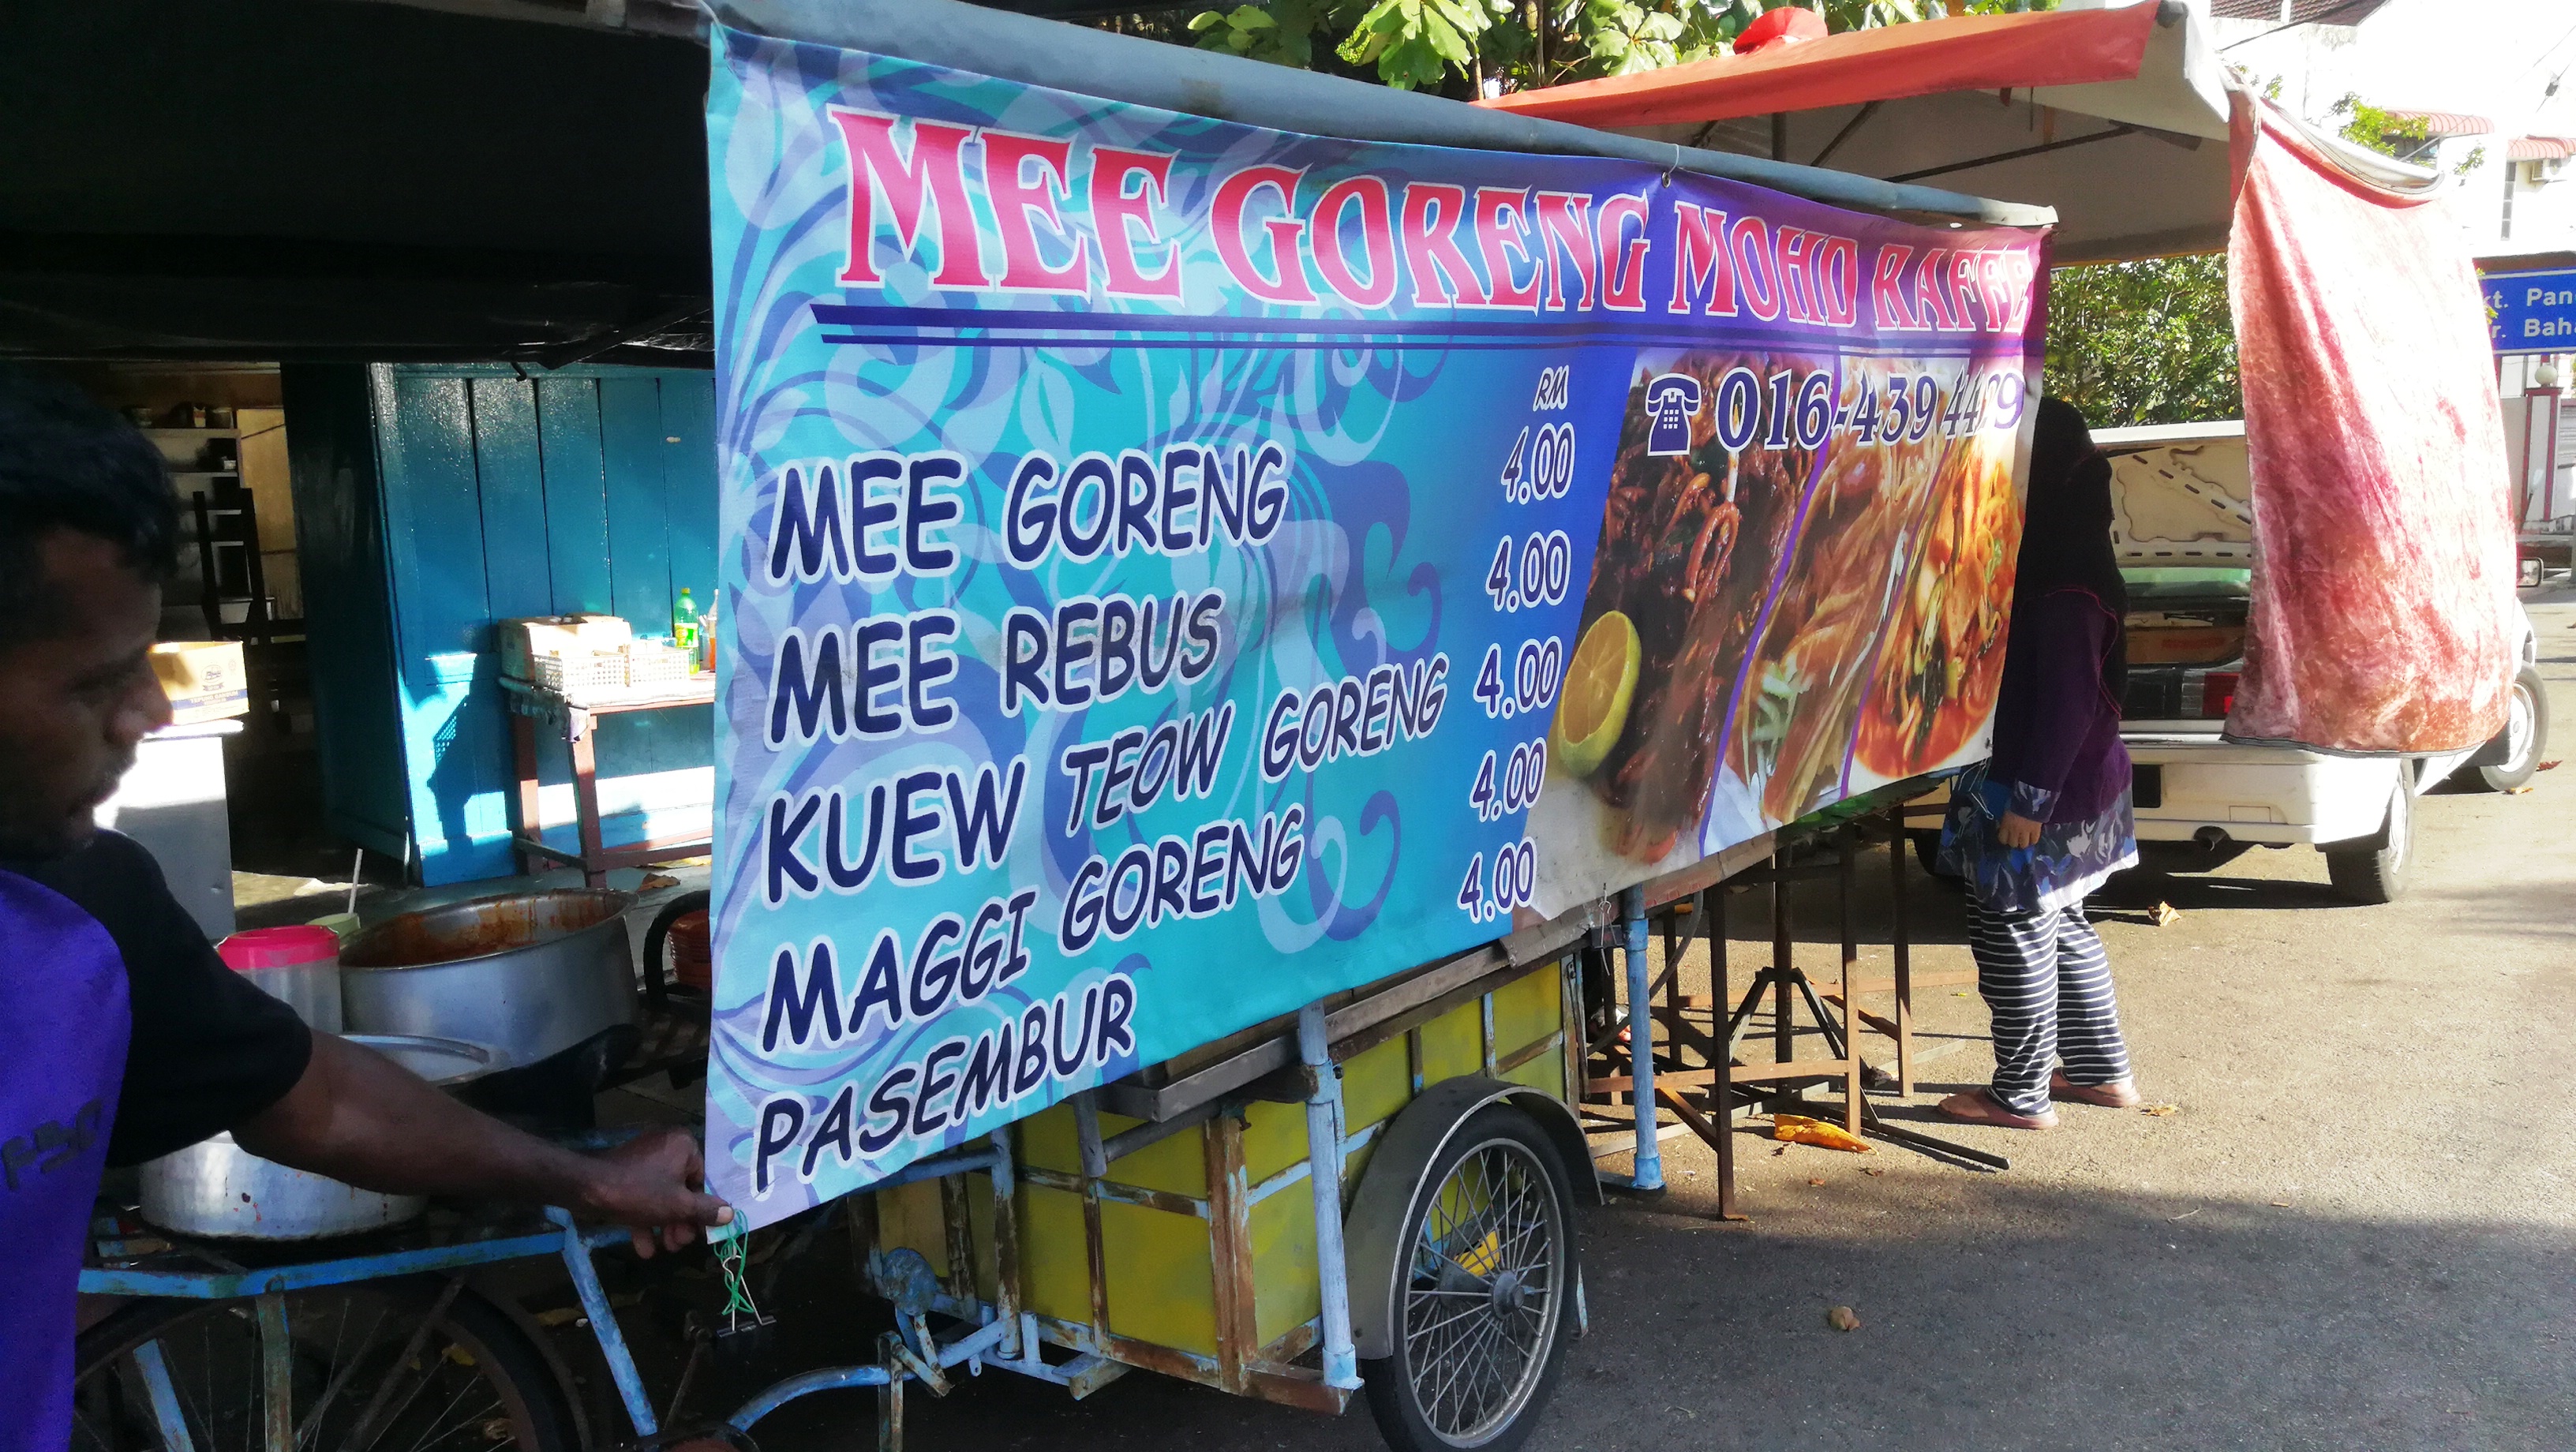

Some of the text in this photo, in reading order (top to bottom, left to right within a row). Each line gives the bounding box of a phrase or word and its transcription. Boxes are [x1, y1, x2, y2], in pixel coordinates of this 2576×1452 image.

[826, 103, 1185, 305] MEE
[1209, 163, 1650, 316] GORENG
[1668, 200, 1859, 328] MOHD
[2524, 316, 2576, 337] Bah
[2526, 287, 2576, 307] Pan
[1533, 365, 1569, 411] RM
[1500, 422, 1575, 504] 4.00
[764, 440, 1291, 587] MEE GORENG
[1485, 530, 1571, 613] 4.00
[764, 587, 1226, 751] MEE REBUS
[1473, 635, 1563, 720] 4.00
[762, 652, 1450, 911] KUEW TEOW GORENG
[1470, 737, 1547, 822] 4.00
[1457, 836, 1537, 923] 4.00
[758, 803, 1306, 1057] MAGGI GORENG
[751, 973, 1136, 1203] PASEMBUR
